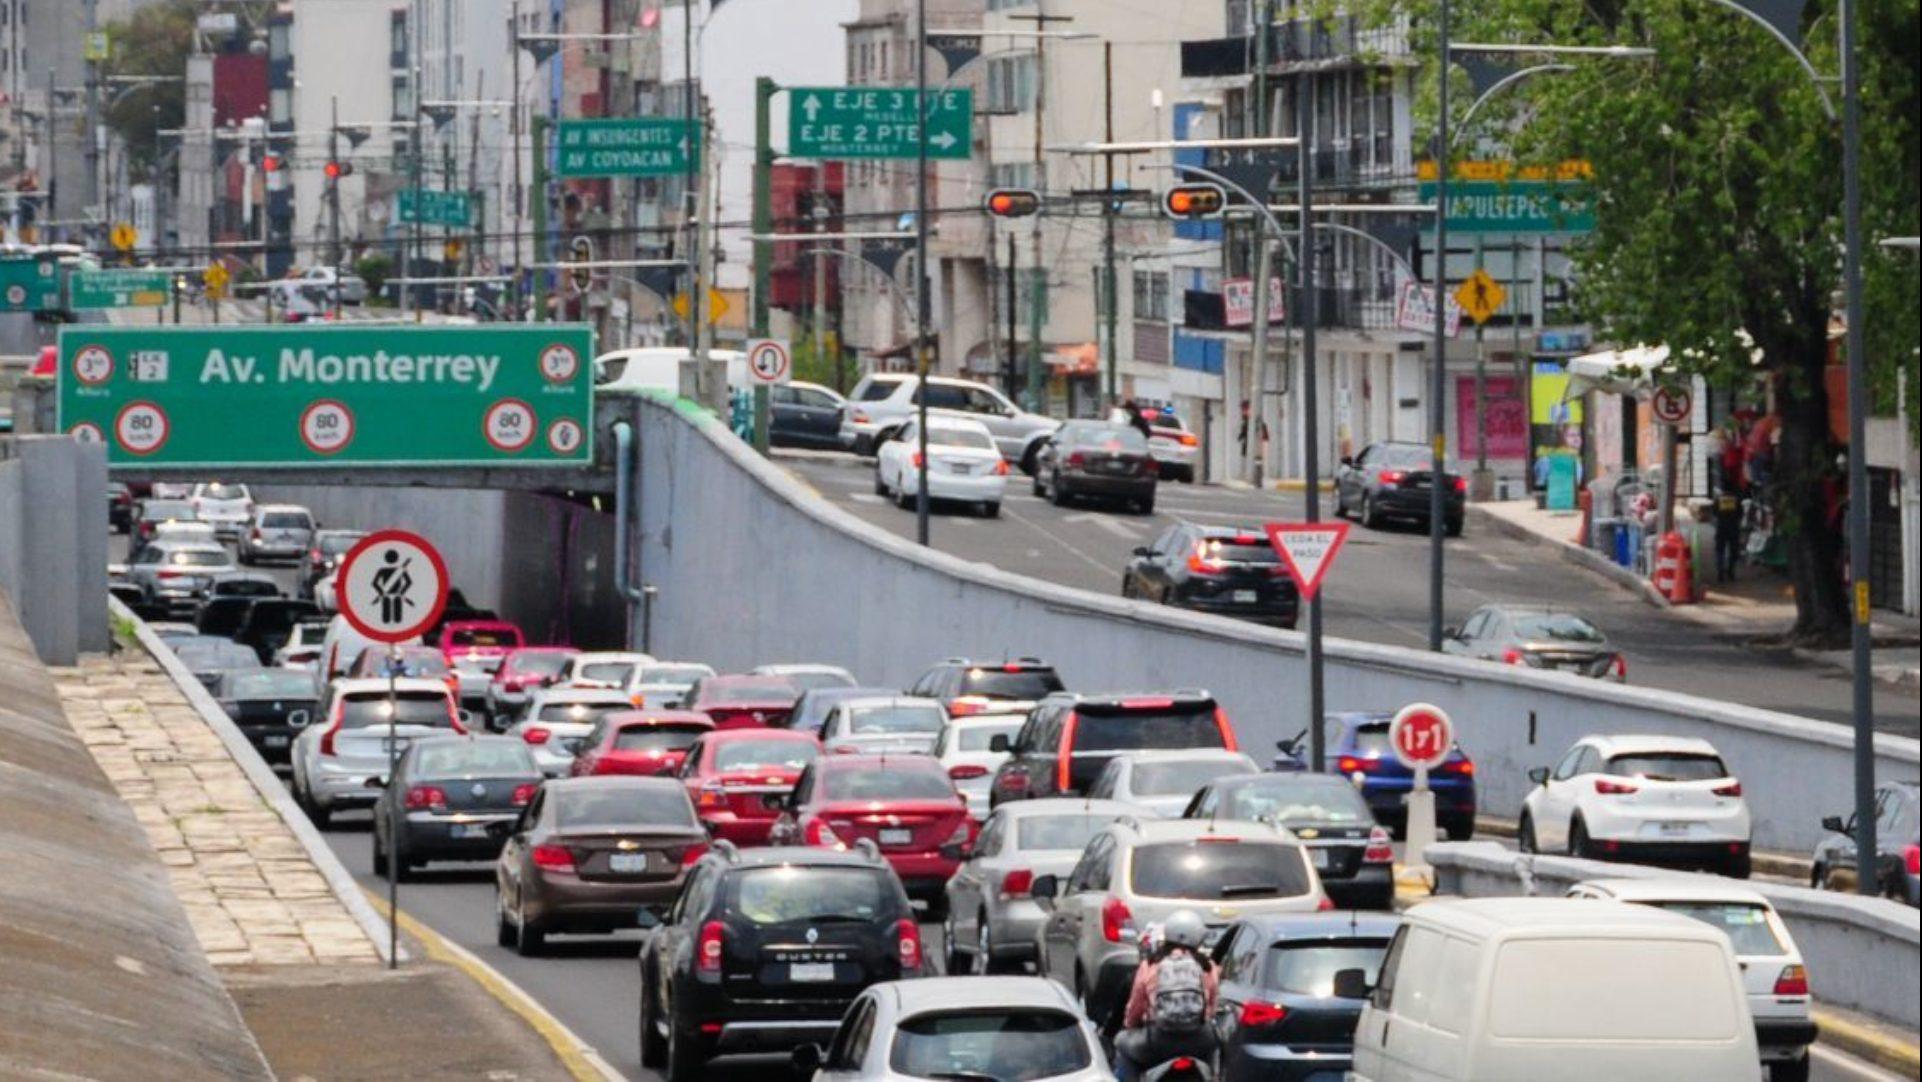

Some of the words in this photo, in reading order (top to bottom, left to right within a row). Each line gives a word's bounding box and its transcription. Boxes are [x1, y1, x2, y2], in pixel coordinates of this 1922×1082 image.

[833, 92, 878, 110] EJE
[890, 92, 904, 110] 3
[565, 129, 582, 145] AV
[586, 127, 673, 145] INSURGENTES
[800, 124, 844, 142] EJE
[853, 124, 868, 142] 2
[877, 124, 920, 142] PTE
[566, 151, 587, 168] AV
[591, 150, 674, 167] COYOACAN
[1428, 194, 1550, 219] APULTEPEC
[199, 347, 265, 384] Av.
[278, 346, 501, 393] Monterrey
[130, 414, 154, 430] 80
[315, 412, 339, 429] 80
[498, 412, 522, 429] 80
[1284, 533, 1313, 543] CEDA
[1316, 534, 1331, 543] EL
[1293, 548, 1322, 559] PASO
[775, 952, 847, 961] DUSTER
